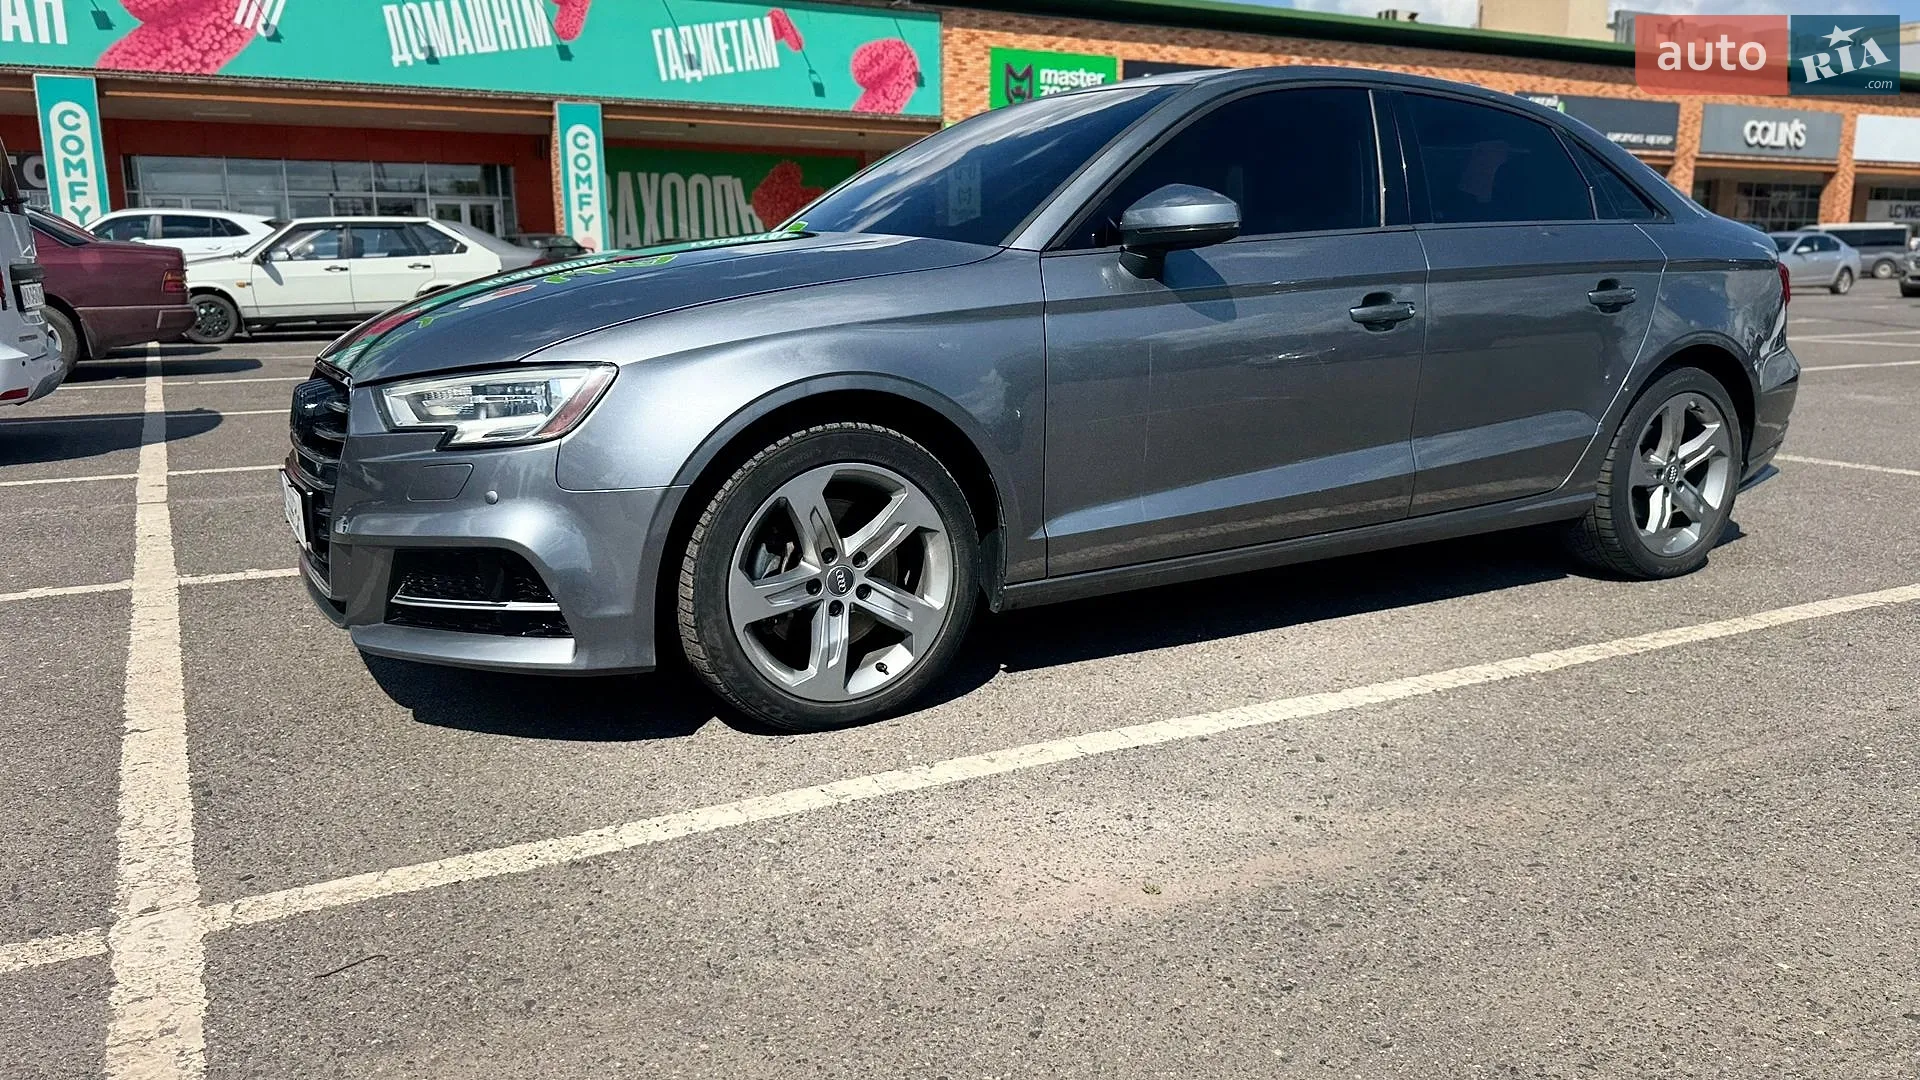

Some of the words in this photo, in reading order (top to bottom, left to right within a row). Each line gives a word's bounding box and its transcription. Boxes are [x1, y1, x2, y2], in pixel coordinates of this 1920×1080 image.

[382, 0, 552, 67] ДОМАШНІМ
[651, 16, 781, 83] ГАДЖЕТАМ
[1039, 67, 1106, 87] master
[1743, 118, 1807, 149] COLIN'S
[57, 109, 92, 226] COMFY
[572, 131, 595, 232] COMFY
